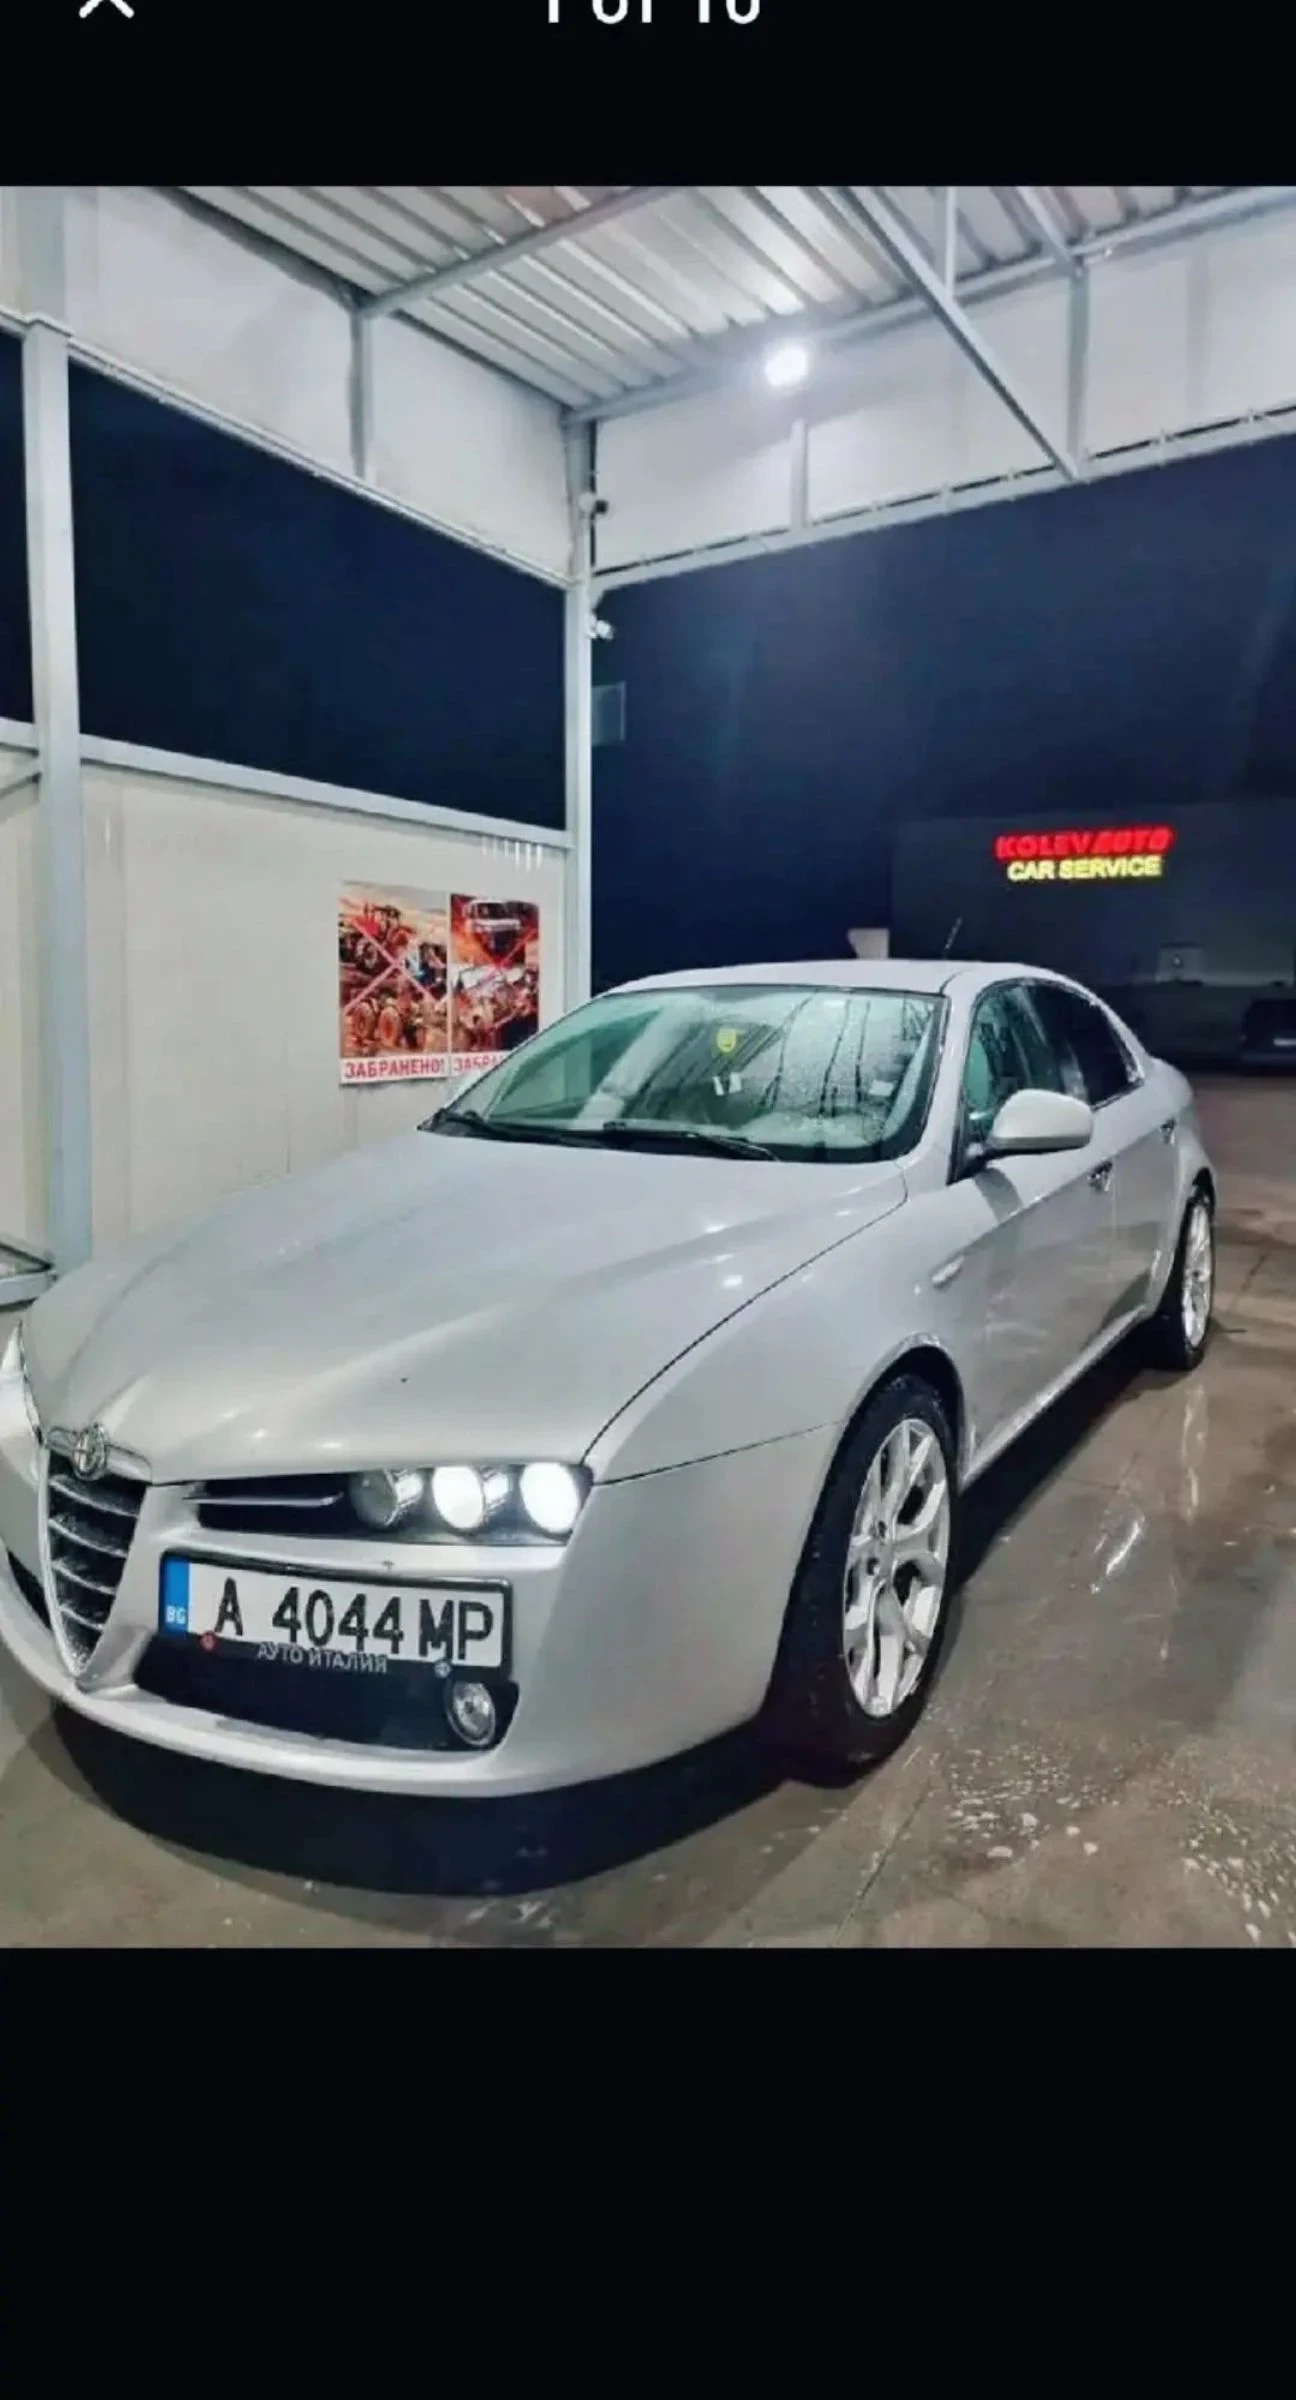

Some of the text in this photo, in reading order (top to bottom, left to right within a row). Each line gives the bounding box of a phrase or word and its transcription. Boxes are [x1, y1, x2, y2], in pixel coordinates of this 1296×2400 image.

[1007, 855, 1162, 882] CAR SERVICE
[344, 1058, 445, 1079] ЗАБРАНЕНО!
[165, 1605, 187, 1624] BG
[214, 1577, 494, 1662] A 4044 MP
[257, 1641, 388, 1673] АУТО ИТАЛИЯ
